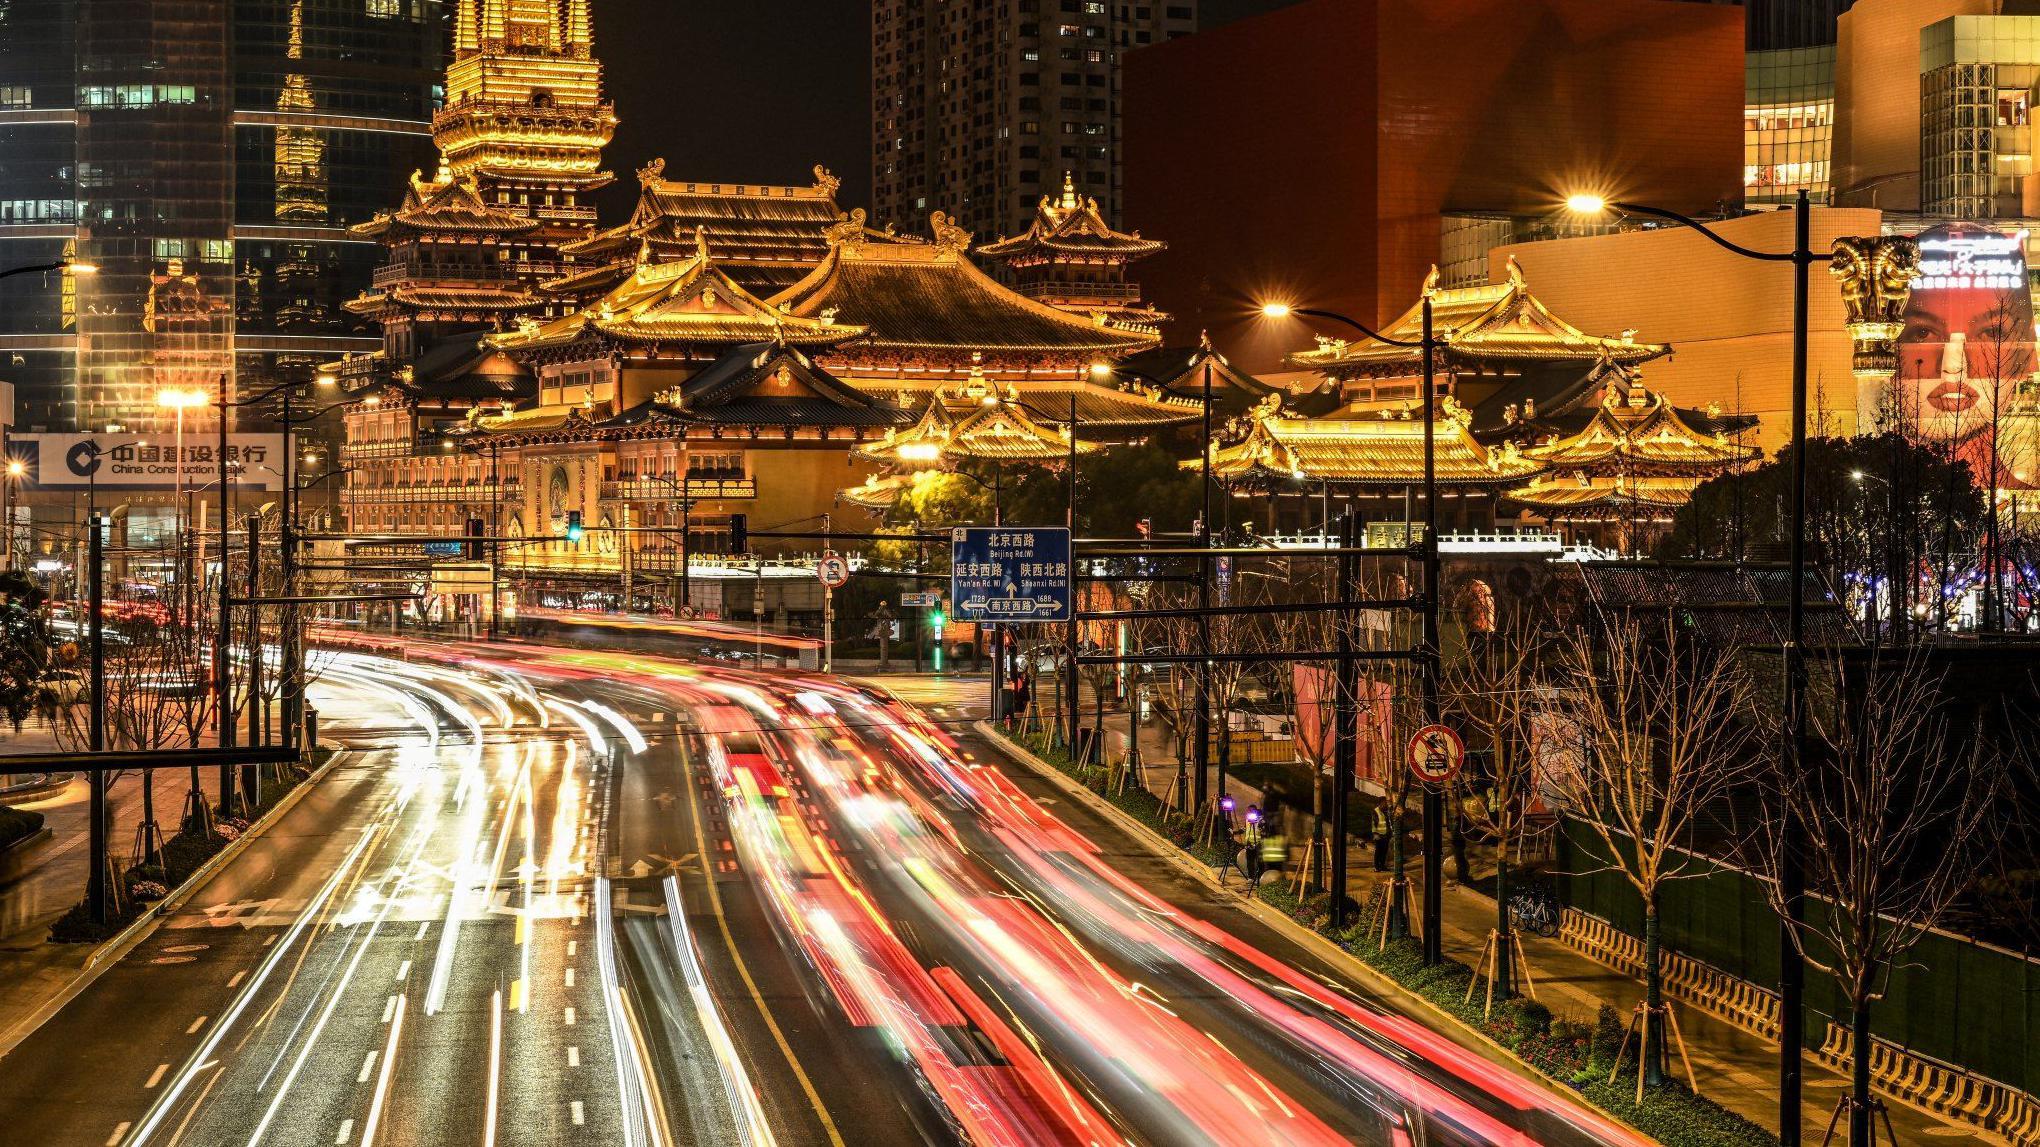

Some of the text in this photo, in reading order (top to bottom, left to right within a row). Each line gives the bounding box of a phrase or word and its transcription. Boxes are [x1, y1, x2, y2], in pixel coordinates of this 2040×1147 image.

[111, 446, 267, 463] 中国建设银行
[111, 464, 143, 474] China
[956, 529, 964, 537] 北
[988, 533, 1035, 548] 北京西路
[990, 550, 1014, 560] Beijing
[956, 563, 1003, 577] 延安西路
[1020, 563, 1067, 577] 陕西北路
[958, 579, 981, 588] Yan'an
[1021, 579, 1047, 588] Shaanxi
[971, 595, 986, 603] 1728
[1037, 594, 1052, 602] 1688
[991, 600, 1031, 611] 南京西路
[972, 608, 985, 617] 1717
[1039, 609, 1052, 617] 1661
